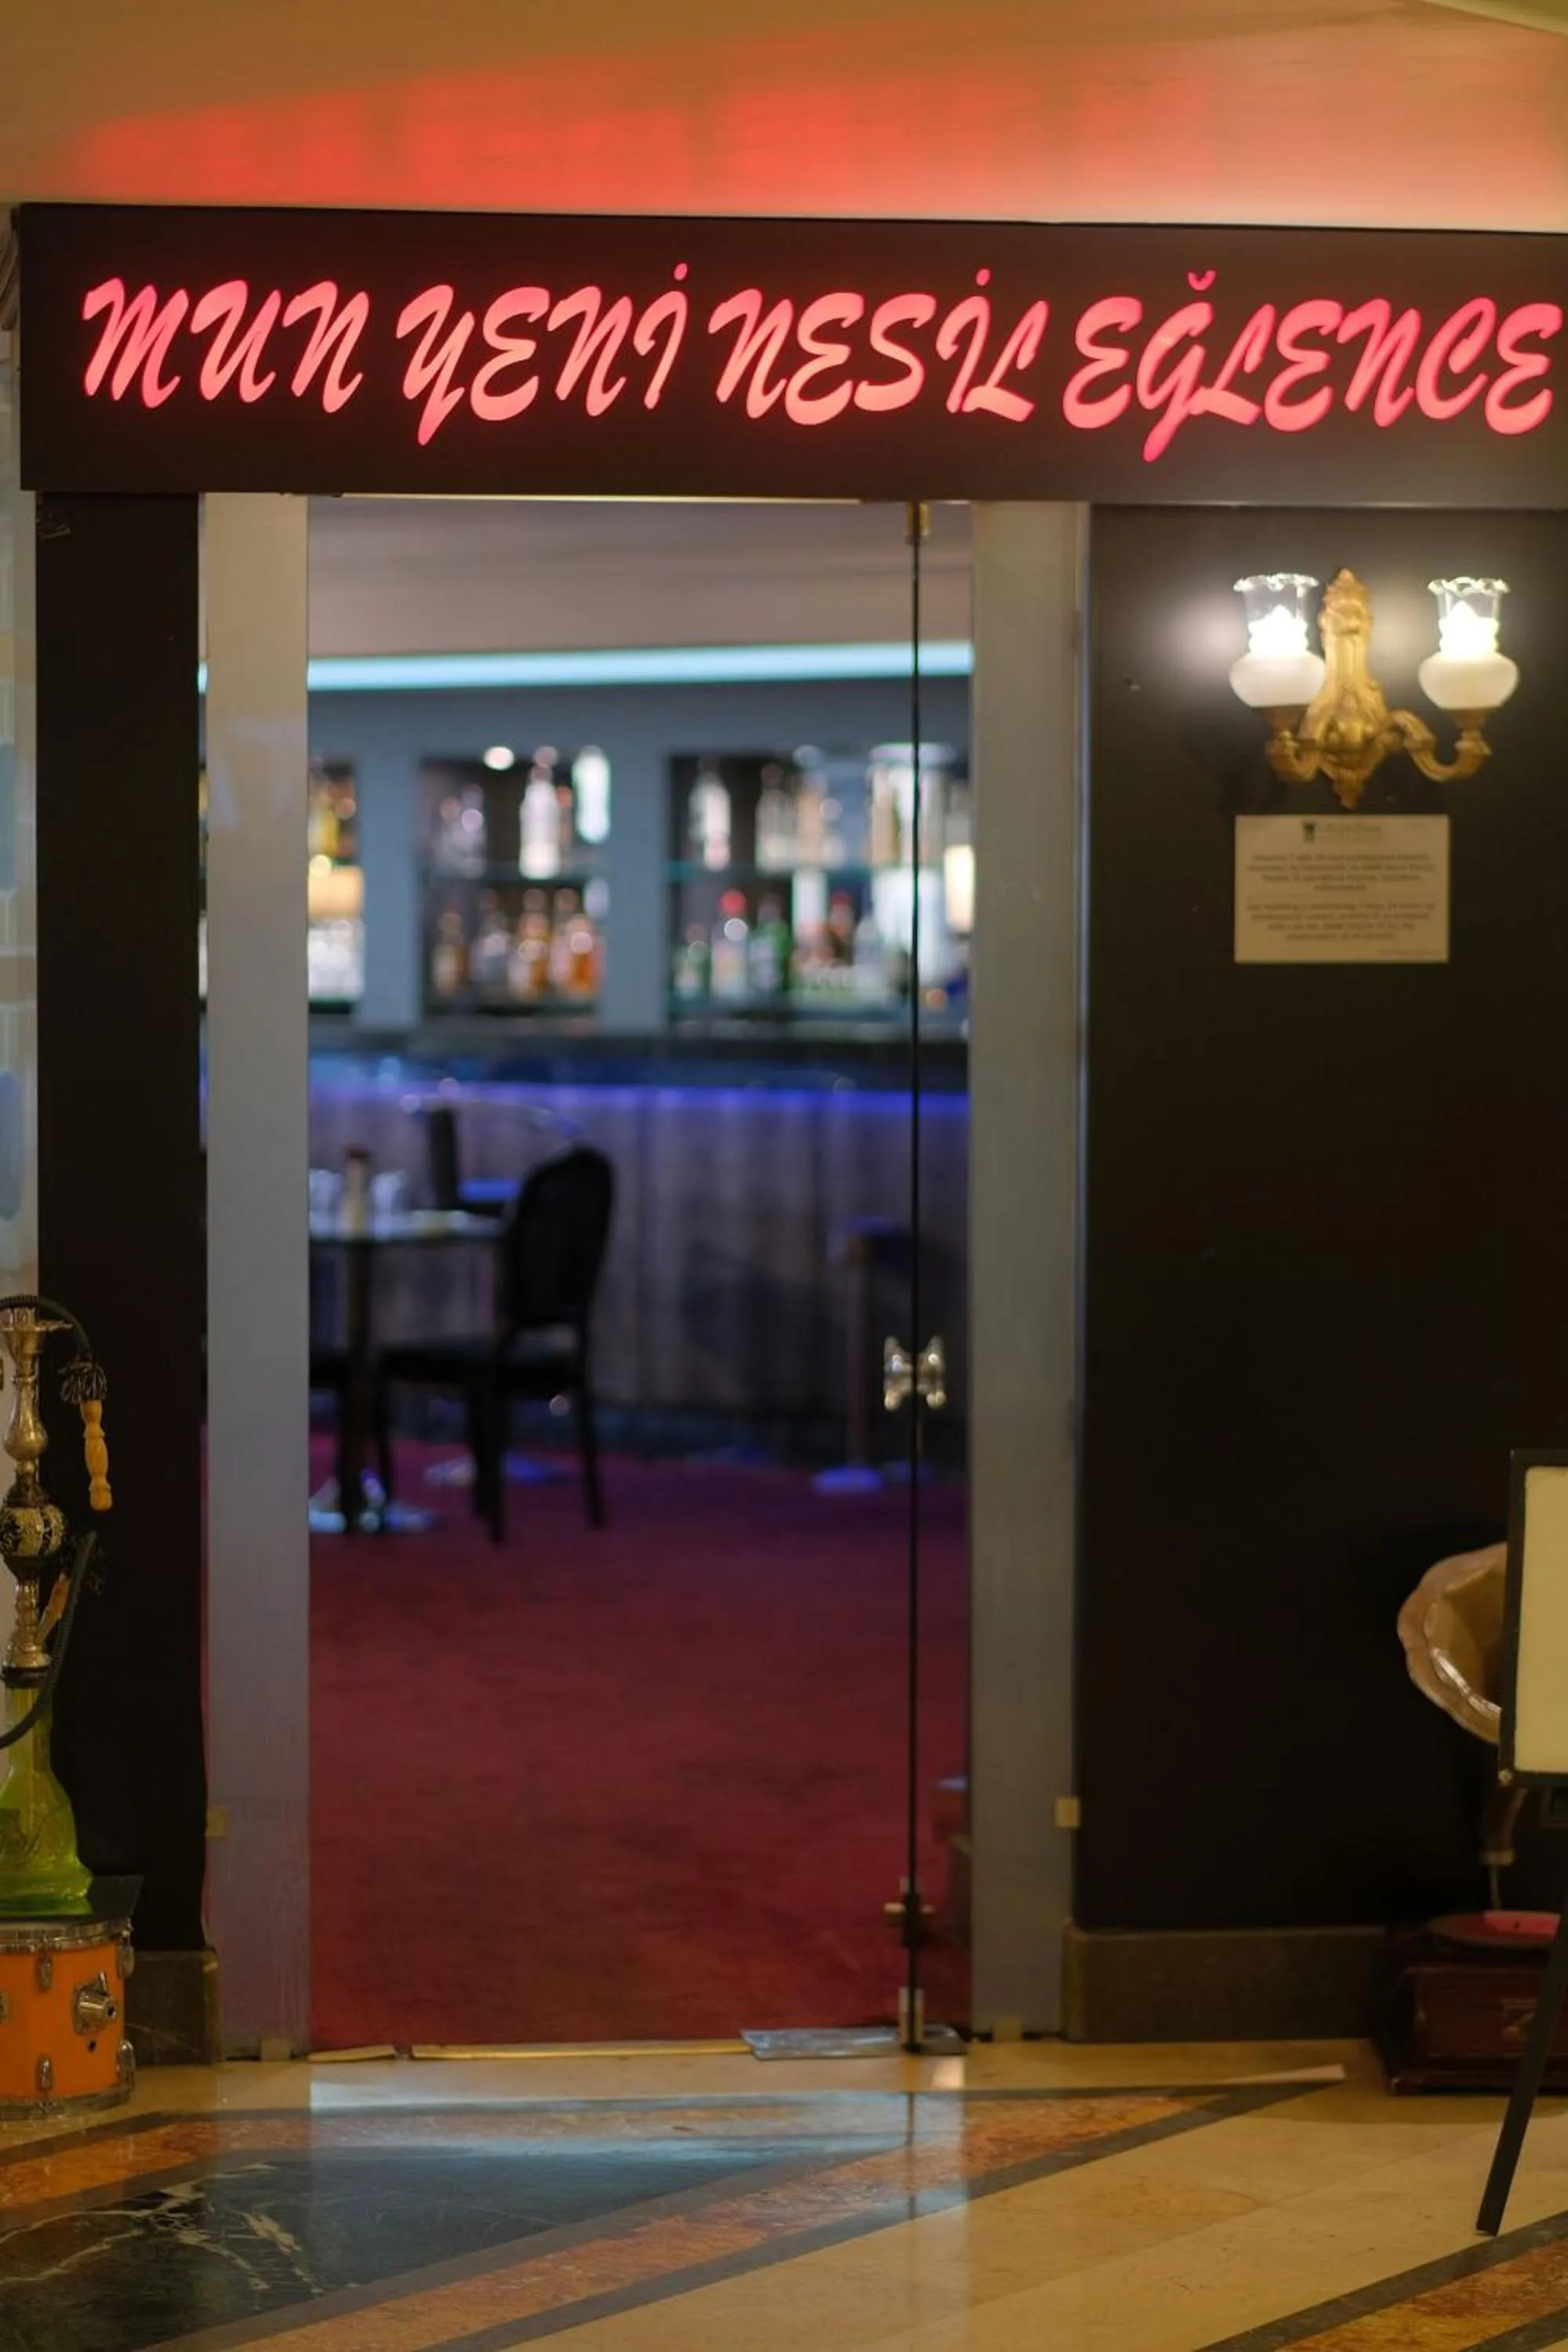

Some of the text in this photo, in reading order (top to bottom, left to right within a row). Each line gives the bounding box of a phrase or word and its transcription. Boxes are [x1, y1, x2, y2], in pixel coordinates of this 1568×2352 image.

[82, 262, 1563, 463] MUN YENİ NESİL EĞLENCE
